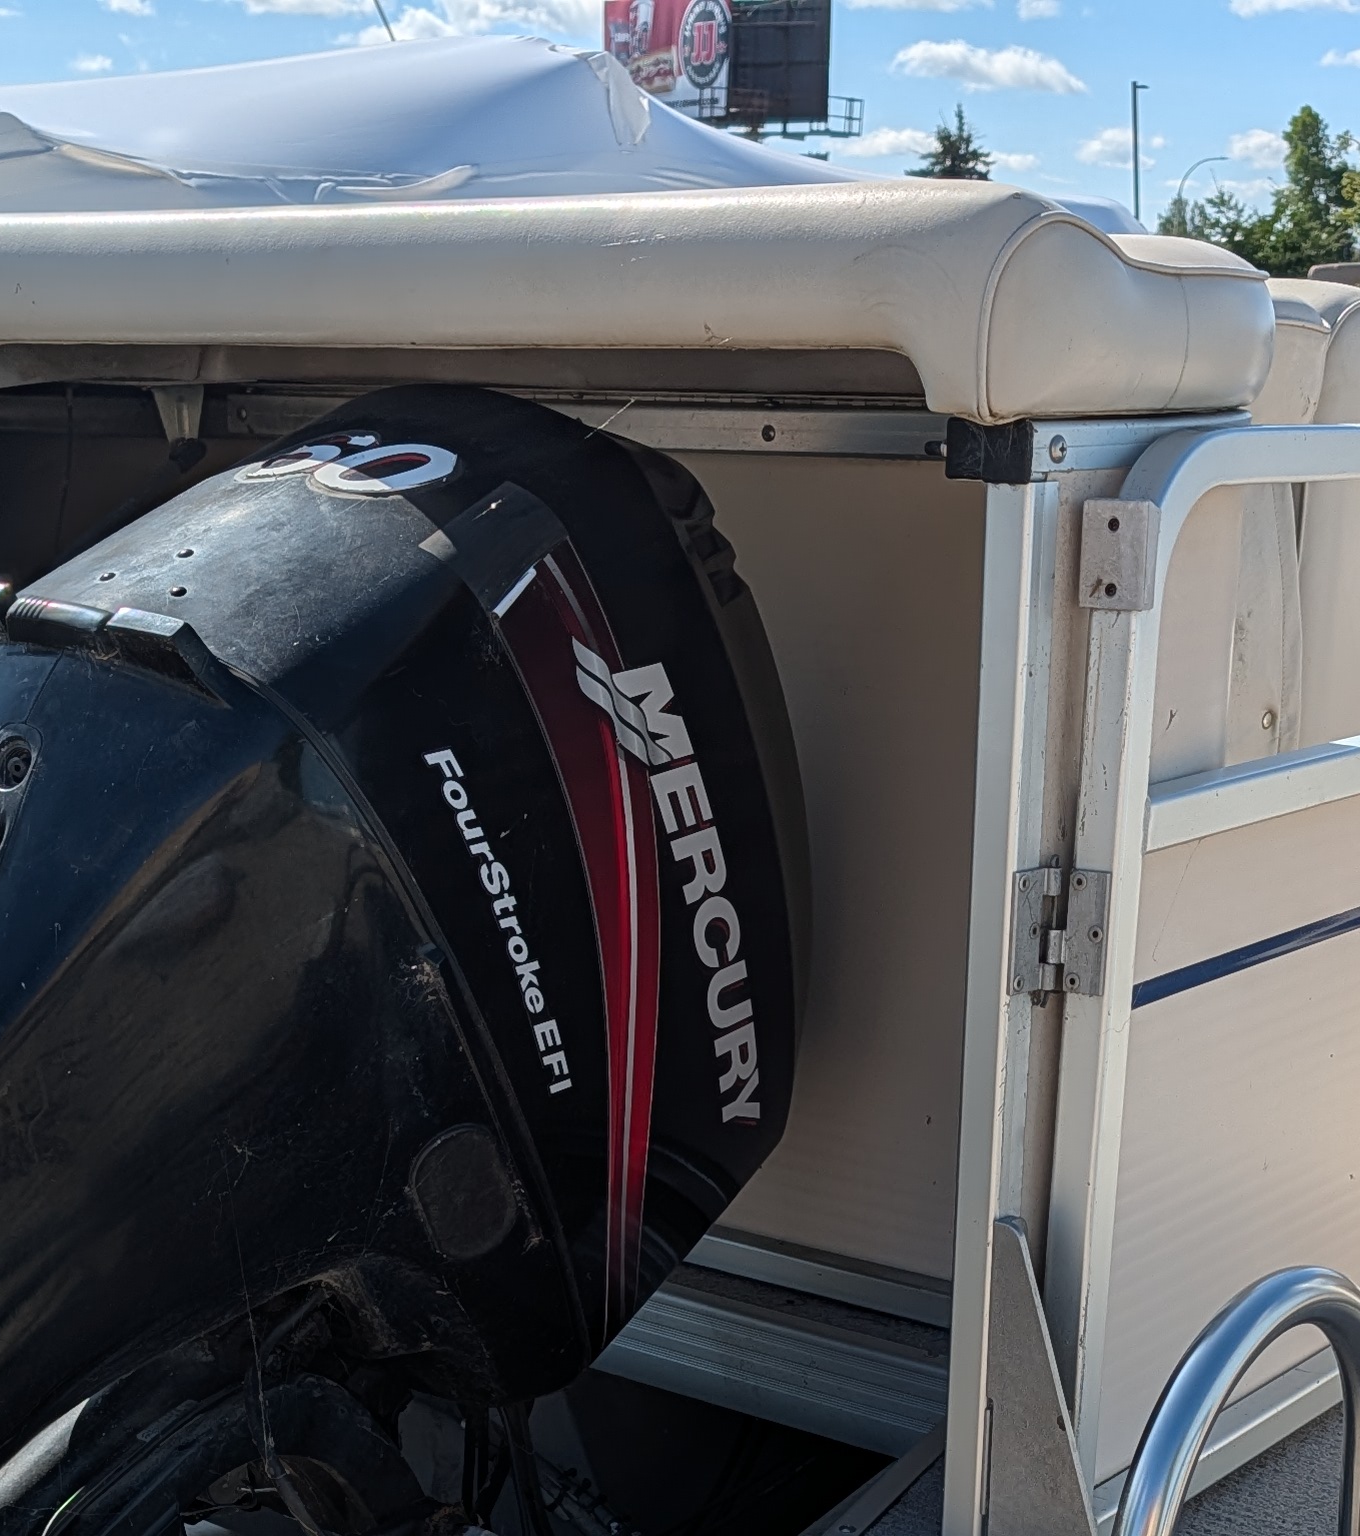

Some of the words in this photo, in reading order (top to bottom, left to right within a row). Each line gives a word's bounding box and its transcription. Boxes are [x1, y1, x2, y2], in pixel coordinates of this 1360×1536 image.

[424, 748, 546, 1015] FourStroke
[533, 1018, 573, 1095] EFI
[573, 637, 761, 1125] MERCURY
